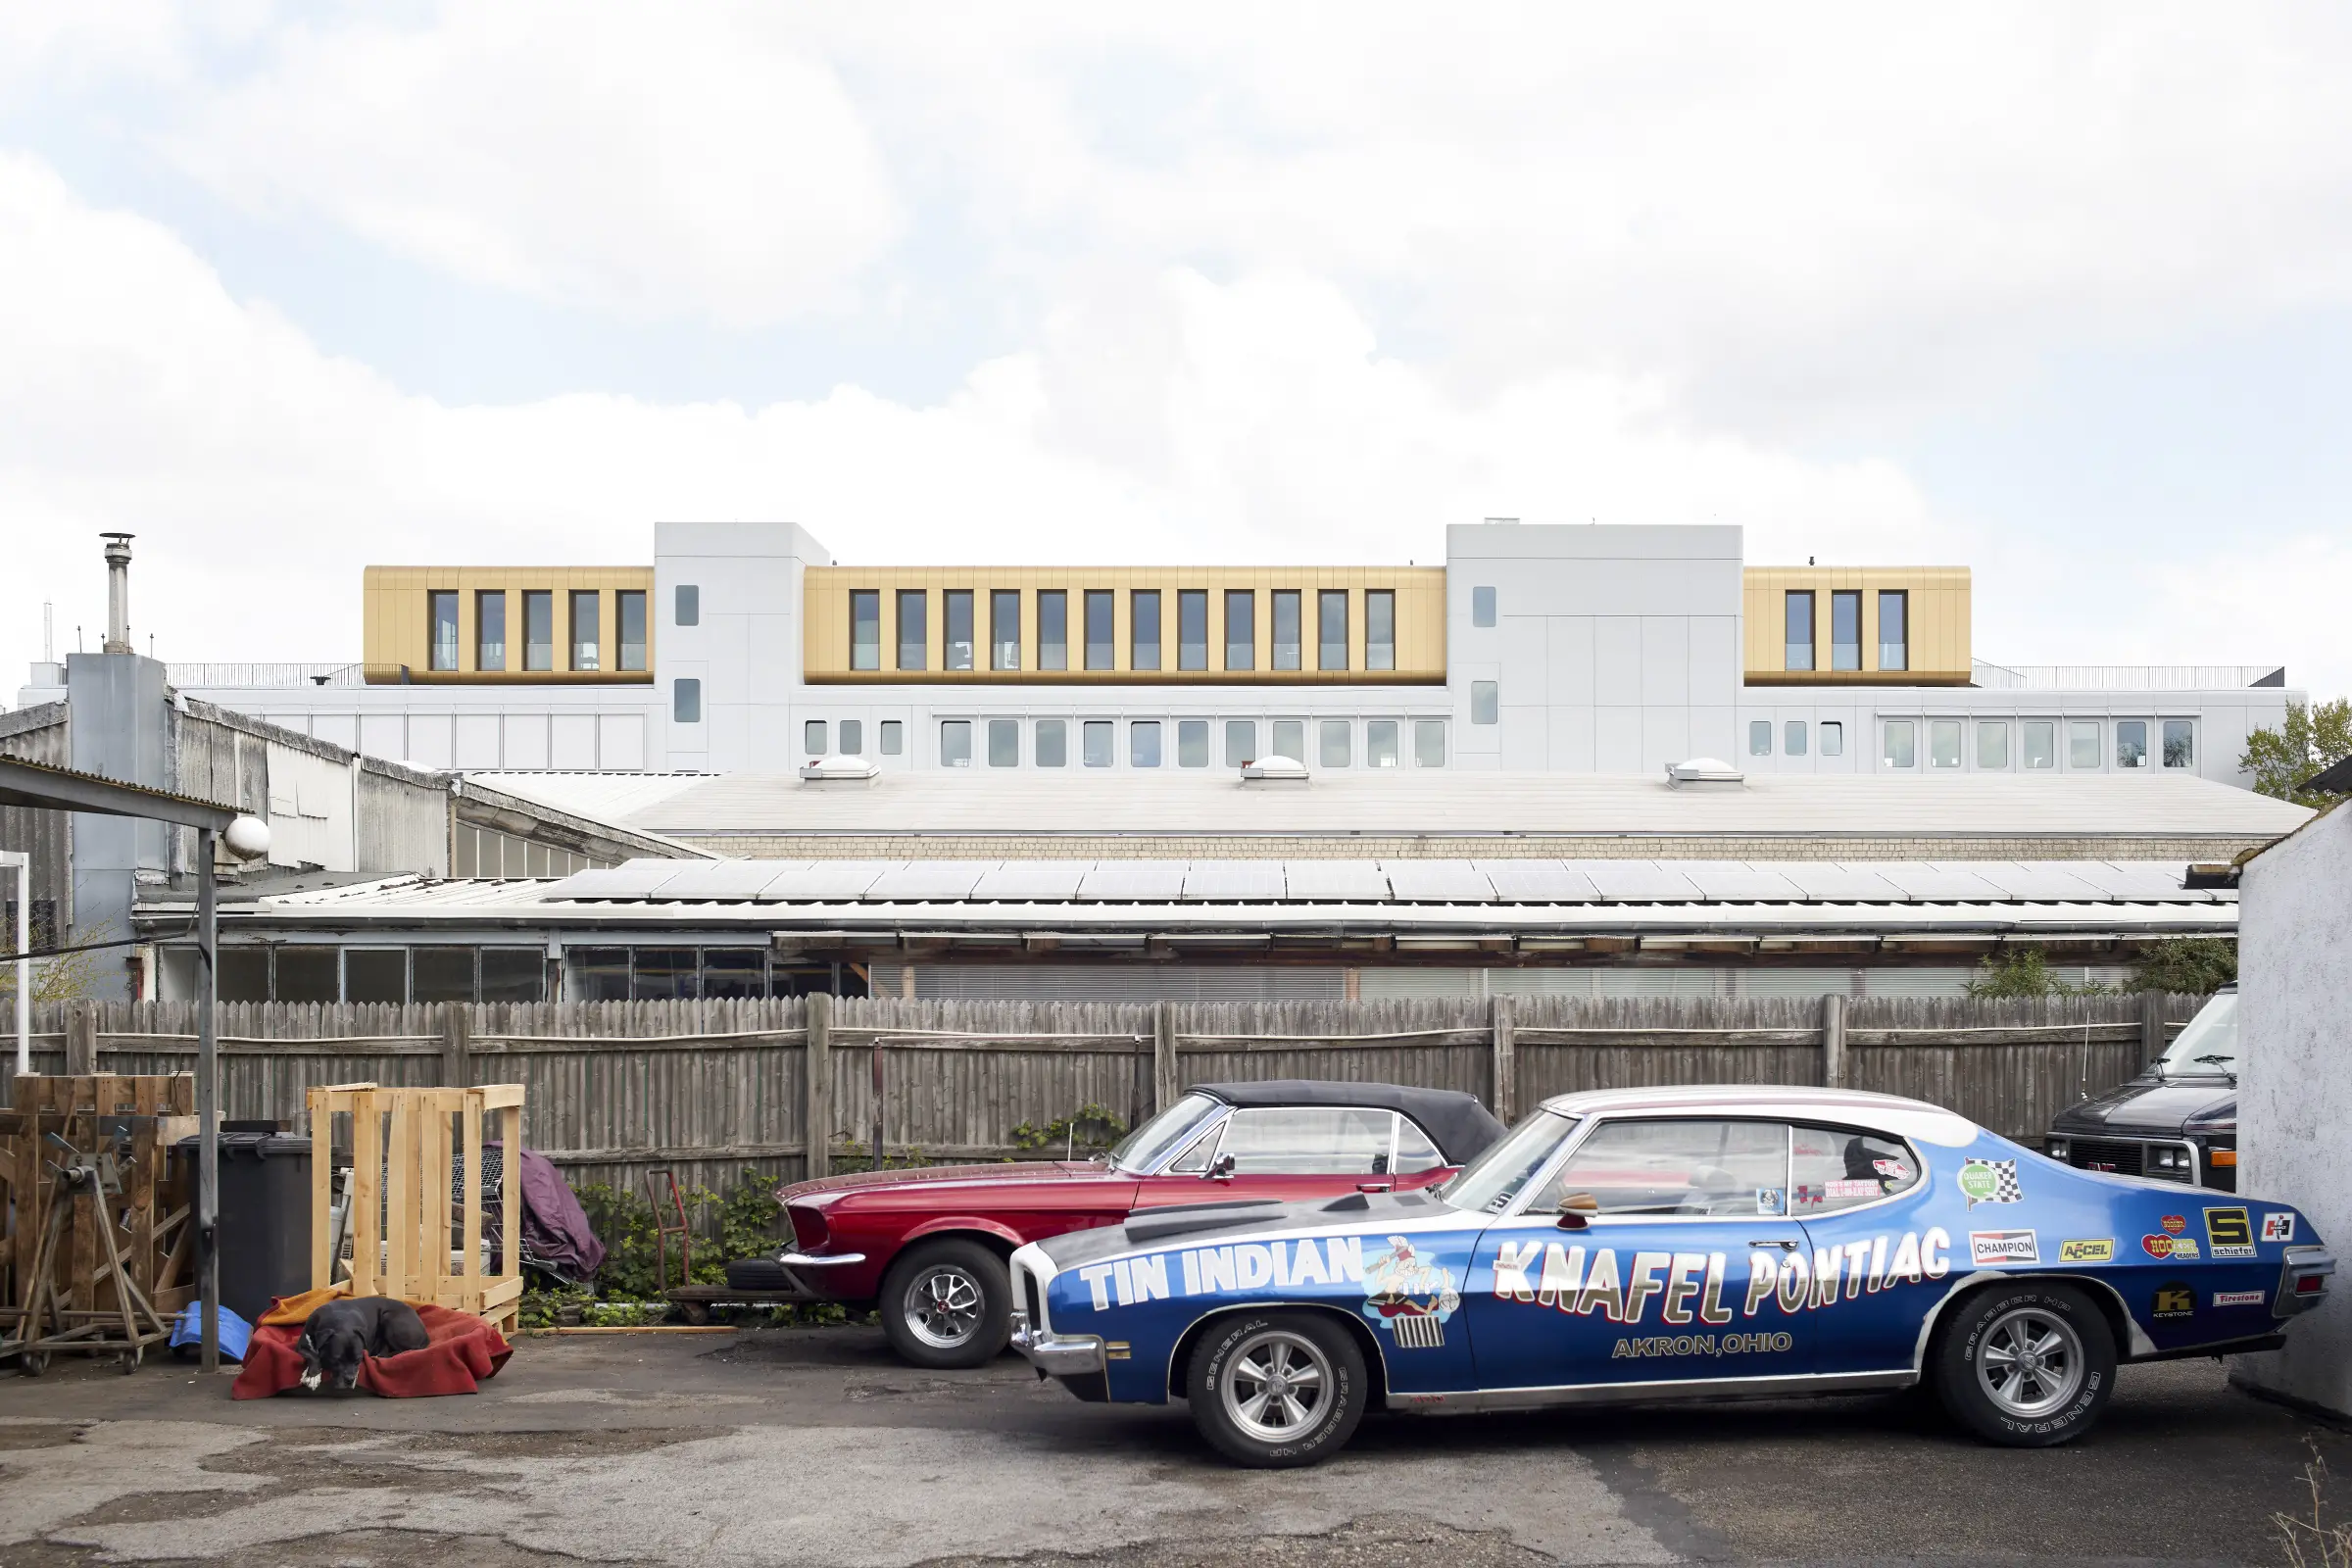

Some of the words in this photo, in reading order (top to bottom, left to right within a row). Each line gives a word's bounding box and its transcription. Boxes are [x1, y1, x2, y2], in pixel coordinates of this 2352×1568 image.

[1963, 1171, 1992, 1180] QUAKER
[1080, 1254, 1170, 1311] TIN
[1182, 1237, 1364, 1296] INDIAN
[1494, 1241, 1733, 1324] KNAFEL
[1743, 1227, 1951, 1316] PONTIAC
[1977, 1242, 2033, 1253] CHAMPION
[2064, 1243, 2108, 1258] ACCEL
[2214, 1247, 2252, 1255] schiefer
[1965, 1295, 2036, 1360] GRABBER
[2220, 1294, 2260, 1303] Firestone
[1206, 1320, 1268, 1390] GENERAL
[1303, 1367, 1348, 1450] GRABBER
[2000, 1372, 2100, 1433] GENERAL
